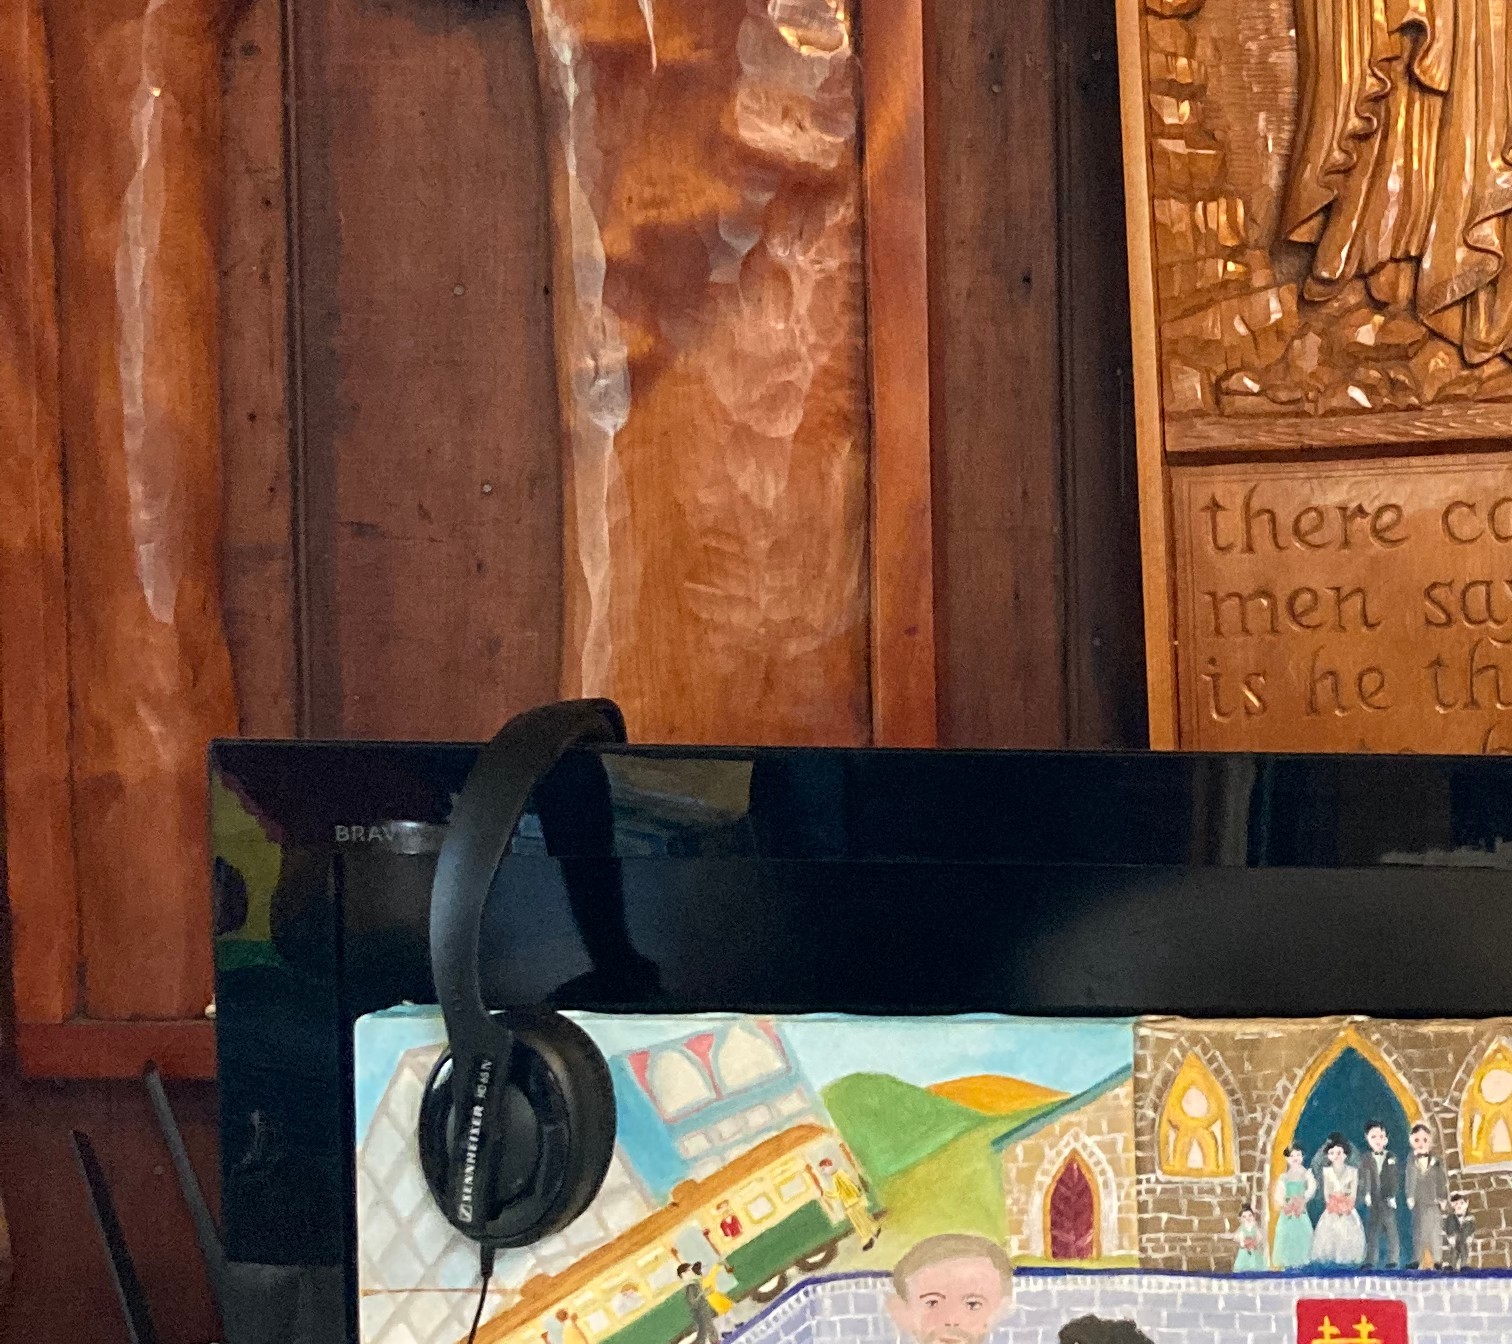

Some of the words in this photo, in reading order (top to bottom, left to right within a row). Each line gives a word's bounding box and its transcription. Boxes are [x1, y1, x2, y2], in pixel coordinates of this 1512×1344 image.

[1201, 483, 1410, 556] there
[1202, 585, 1382, 638] men
[1202, 656, 1268, 721] is
[1304, 644, 1393, 717] he
[462, 1105, 484, 1204] SENNHEISER
